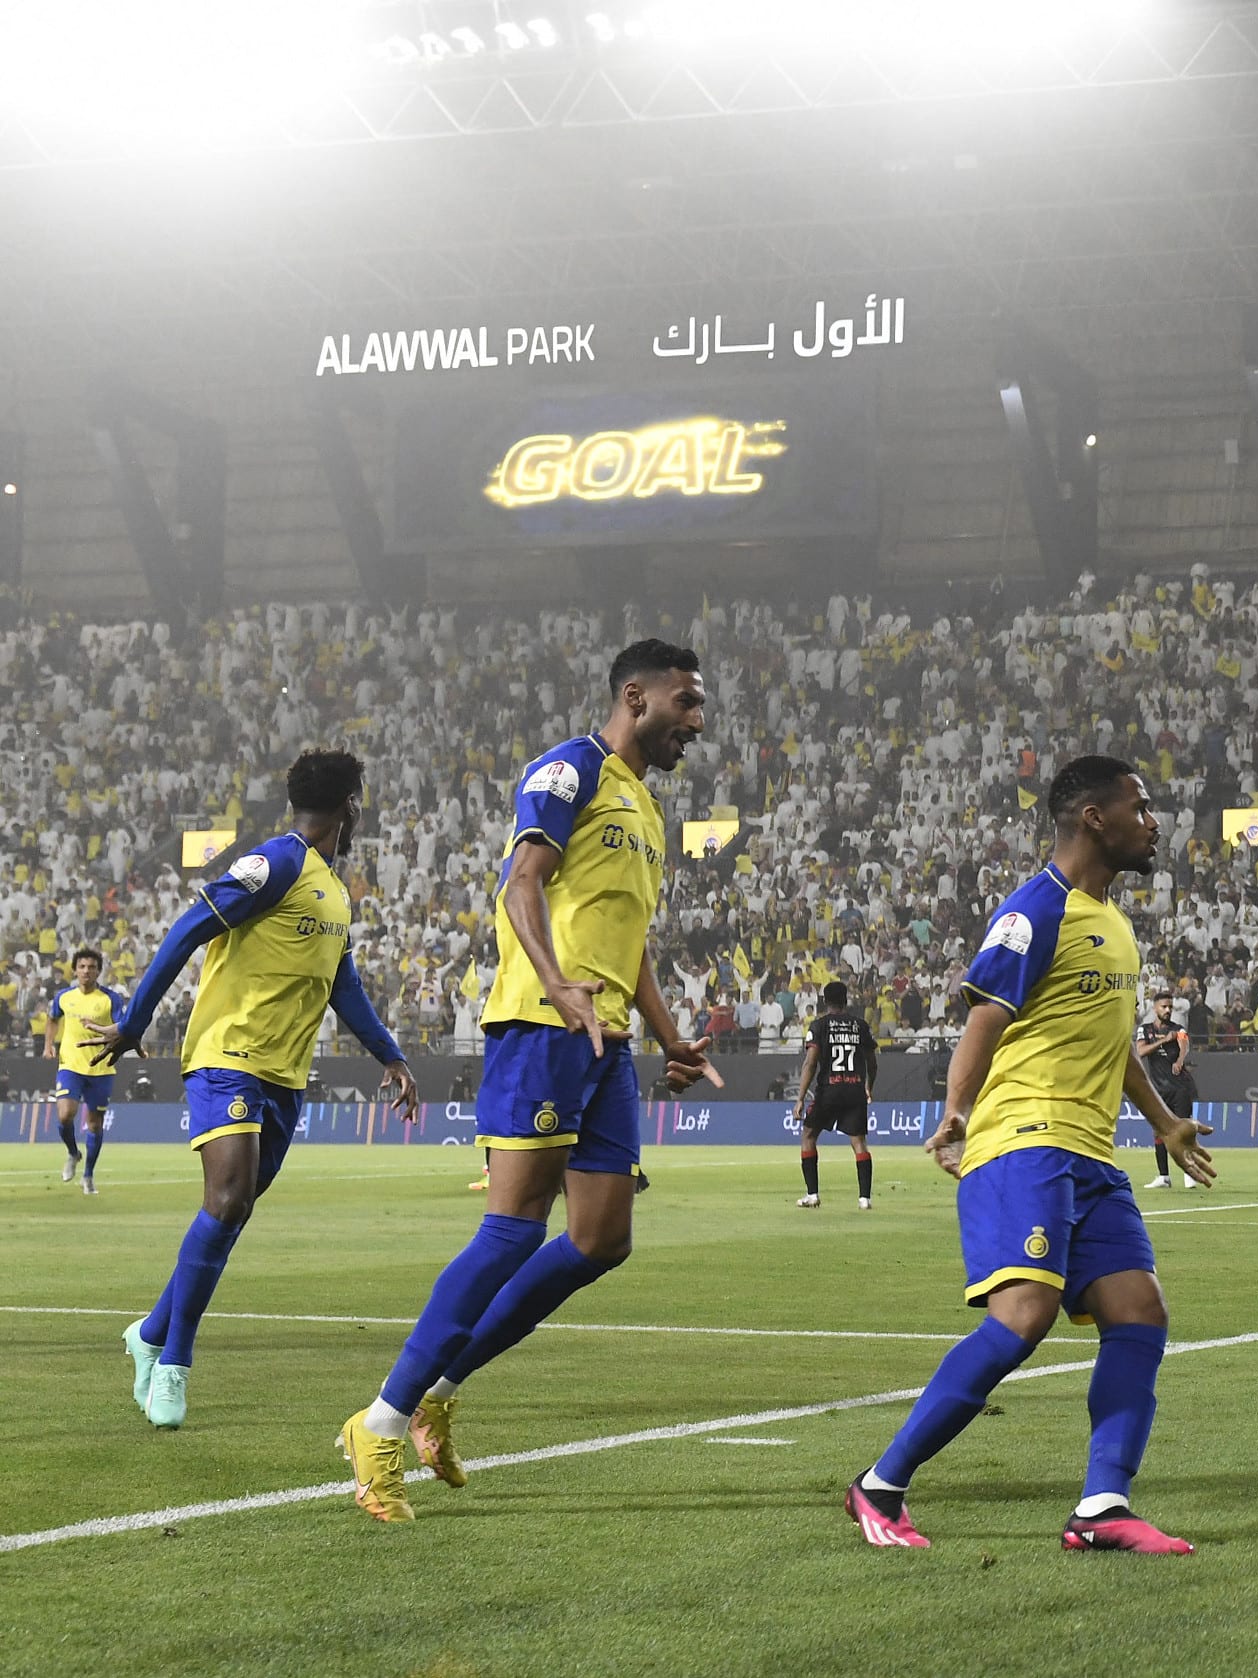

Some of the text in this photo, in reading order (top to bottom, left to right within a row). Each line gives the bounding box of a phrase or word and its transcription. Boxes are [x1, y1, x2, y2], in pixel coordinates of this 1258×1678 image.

[316, 324, 595, 376] ALAWWAL PARK
[792, 294, 905, 359] الأول
[498, 422, 764, 506] GOAL
[832, 1044, 856, 1072] 27
